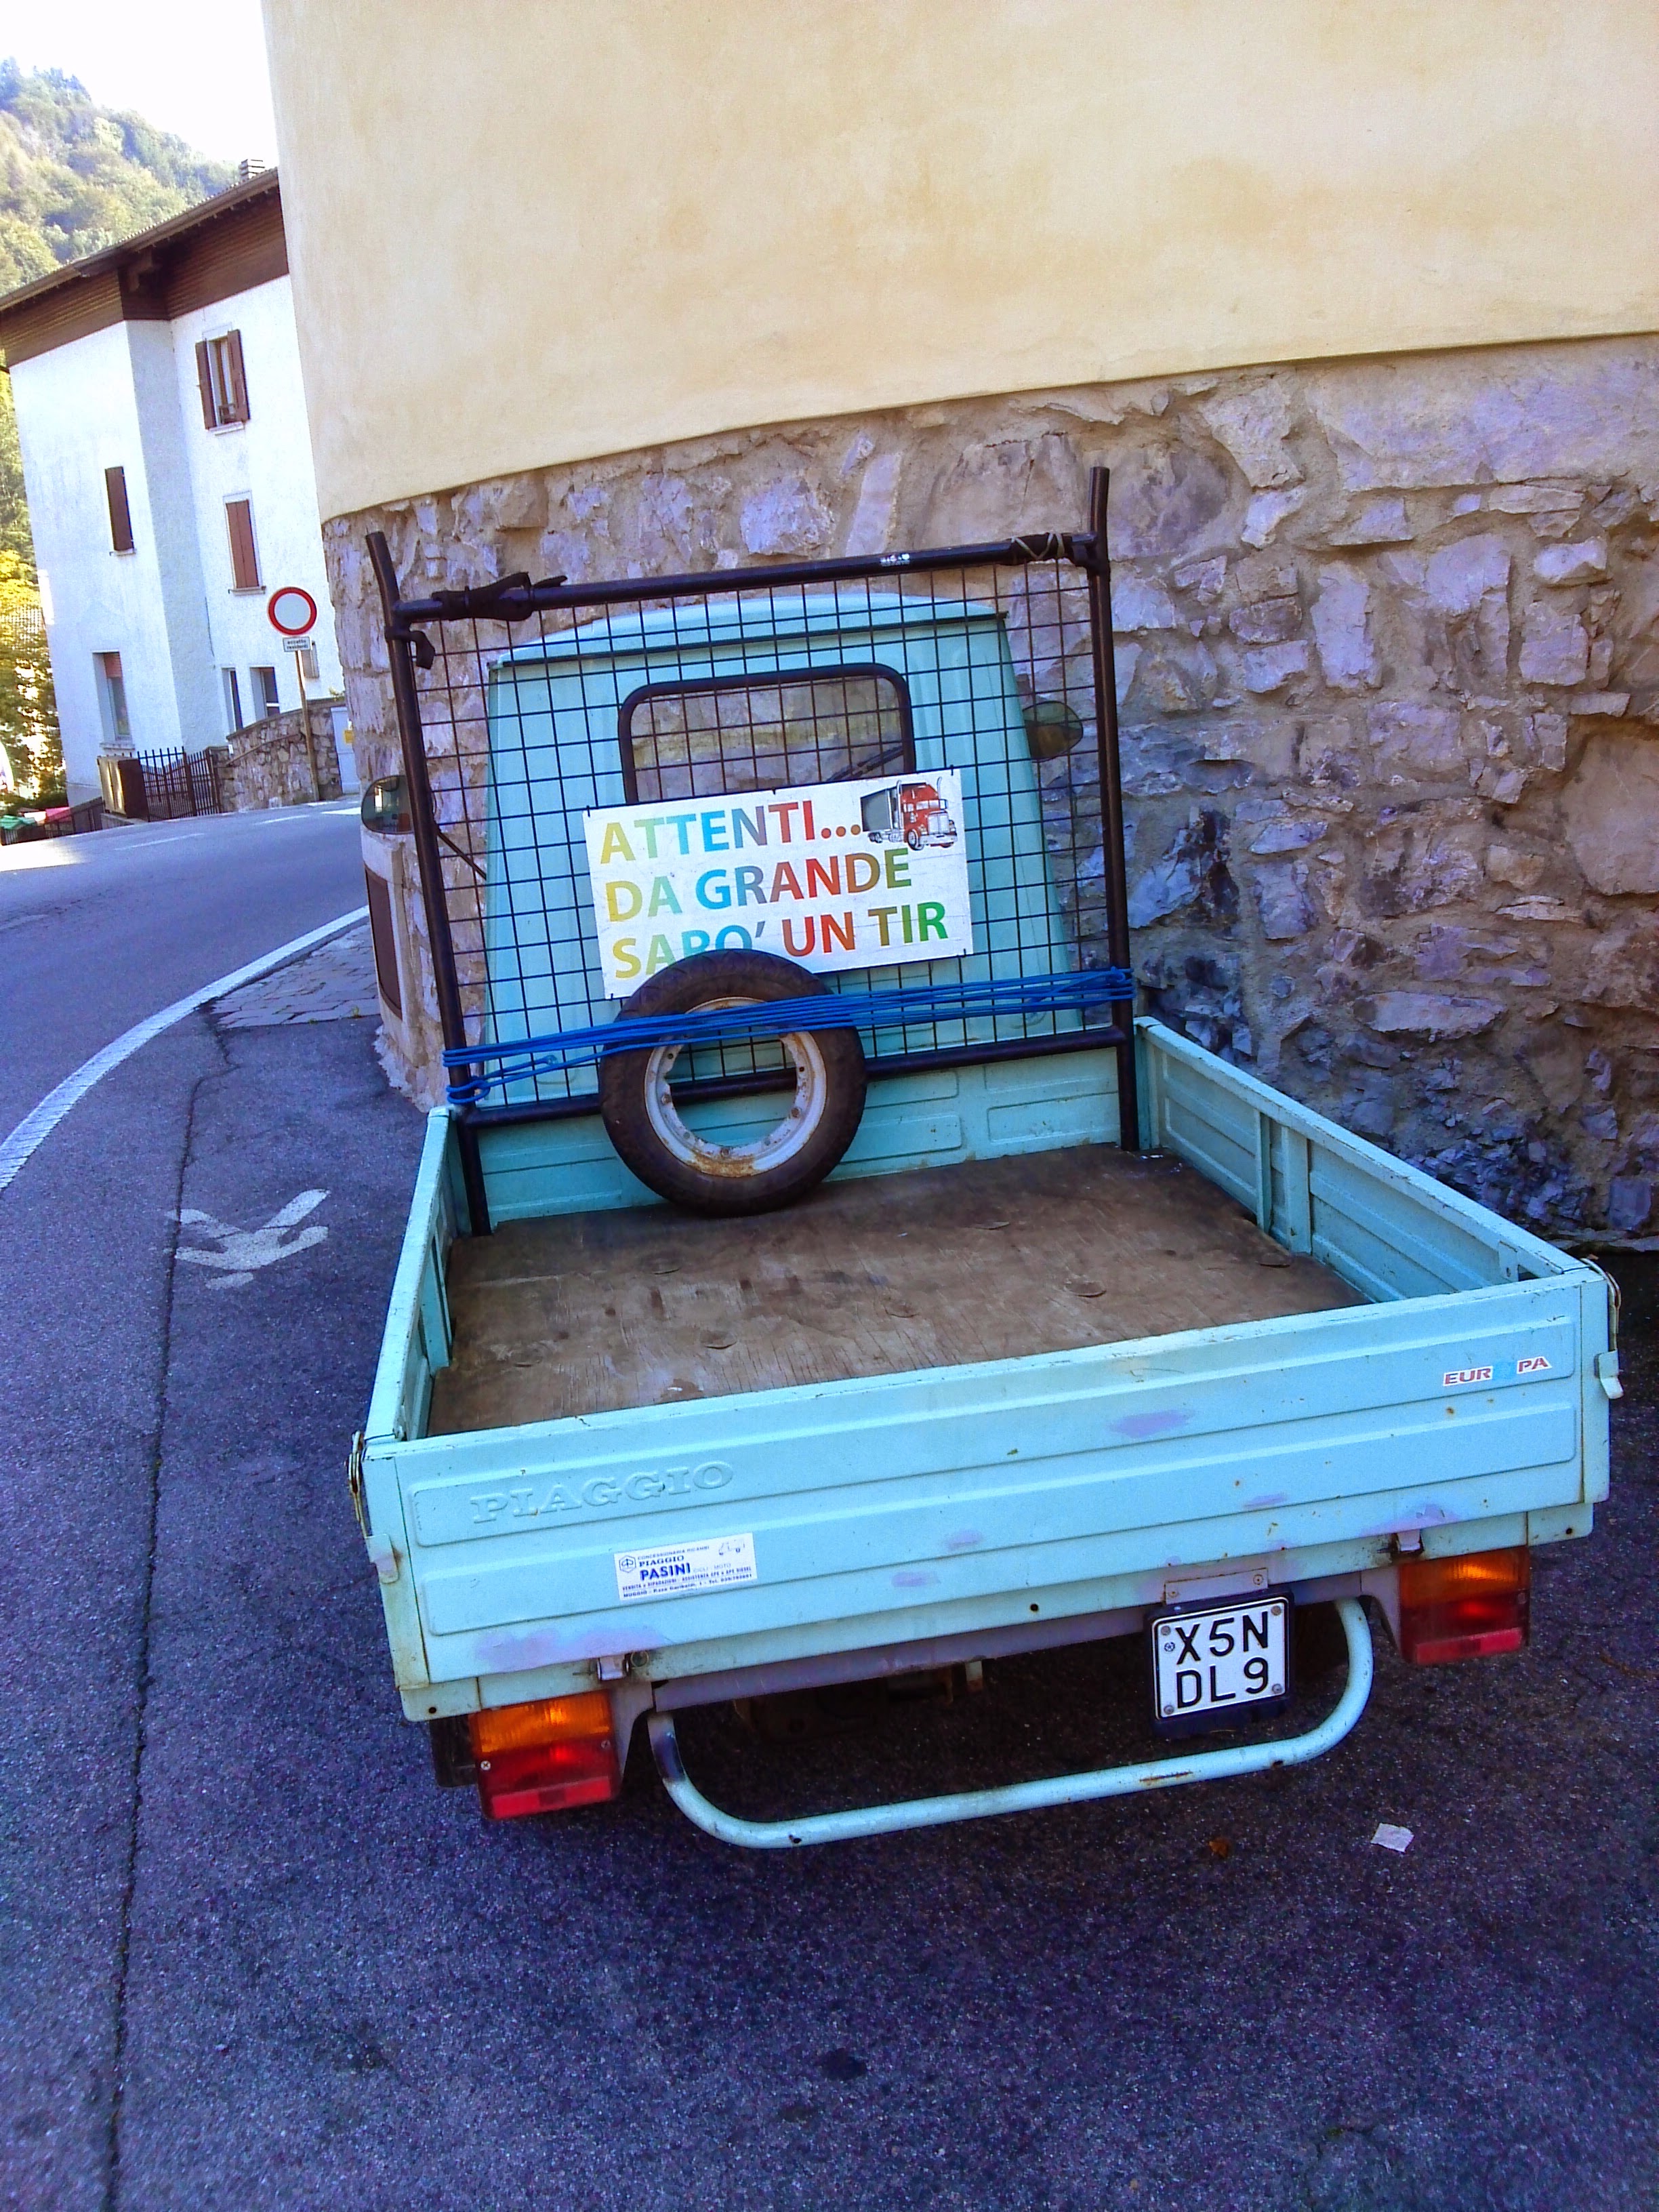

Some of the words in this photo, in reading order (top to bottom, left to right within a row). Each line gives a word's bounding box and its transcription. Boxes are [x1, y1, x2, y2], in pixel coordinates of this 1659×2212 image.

[600, 800, 861, 864] ATTENTI...
[605, 876, 682, 922] DA
[695, 848, 912, 910] GRANDE
[782, 912, 856, 957] UN
[868, 901, 949, 947] TIR
[470, 1460, 734, 1523] PIAGGIO
[639, 1555, 684, 1567] PIAGGIO
[640, 1562, 691, 1580] PASINI
[1175, 1611, 1268, 1665] X5N
[1176, 1657, 1269, 1708] DL9
